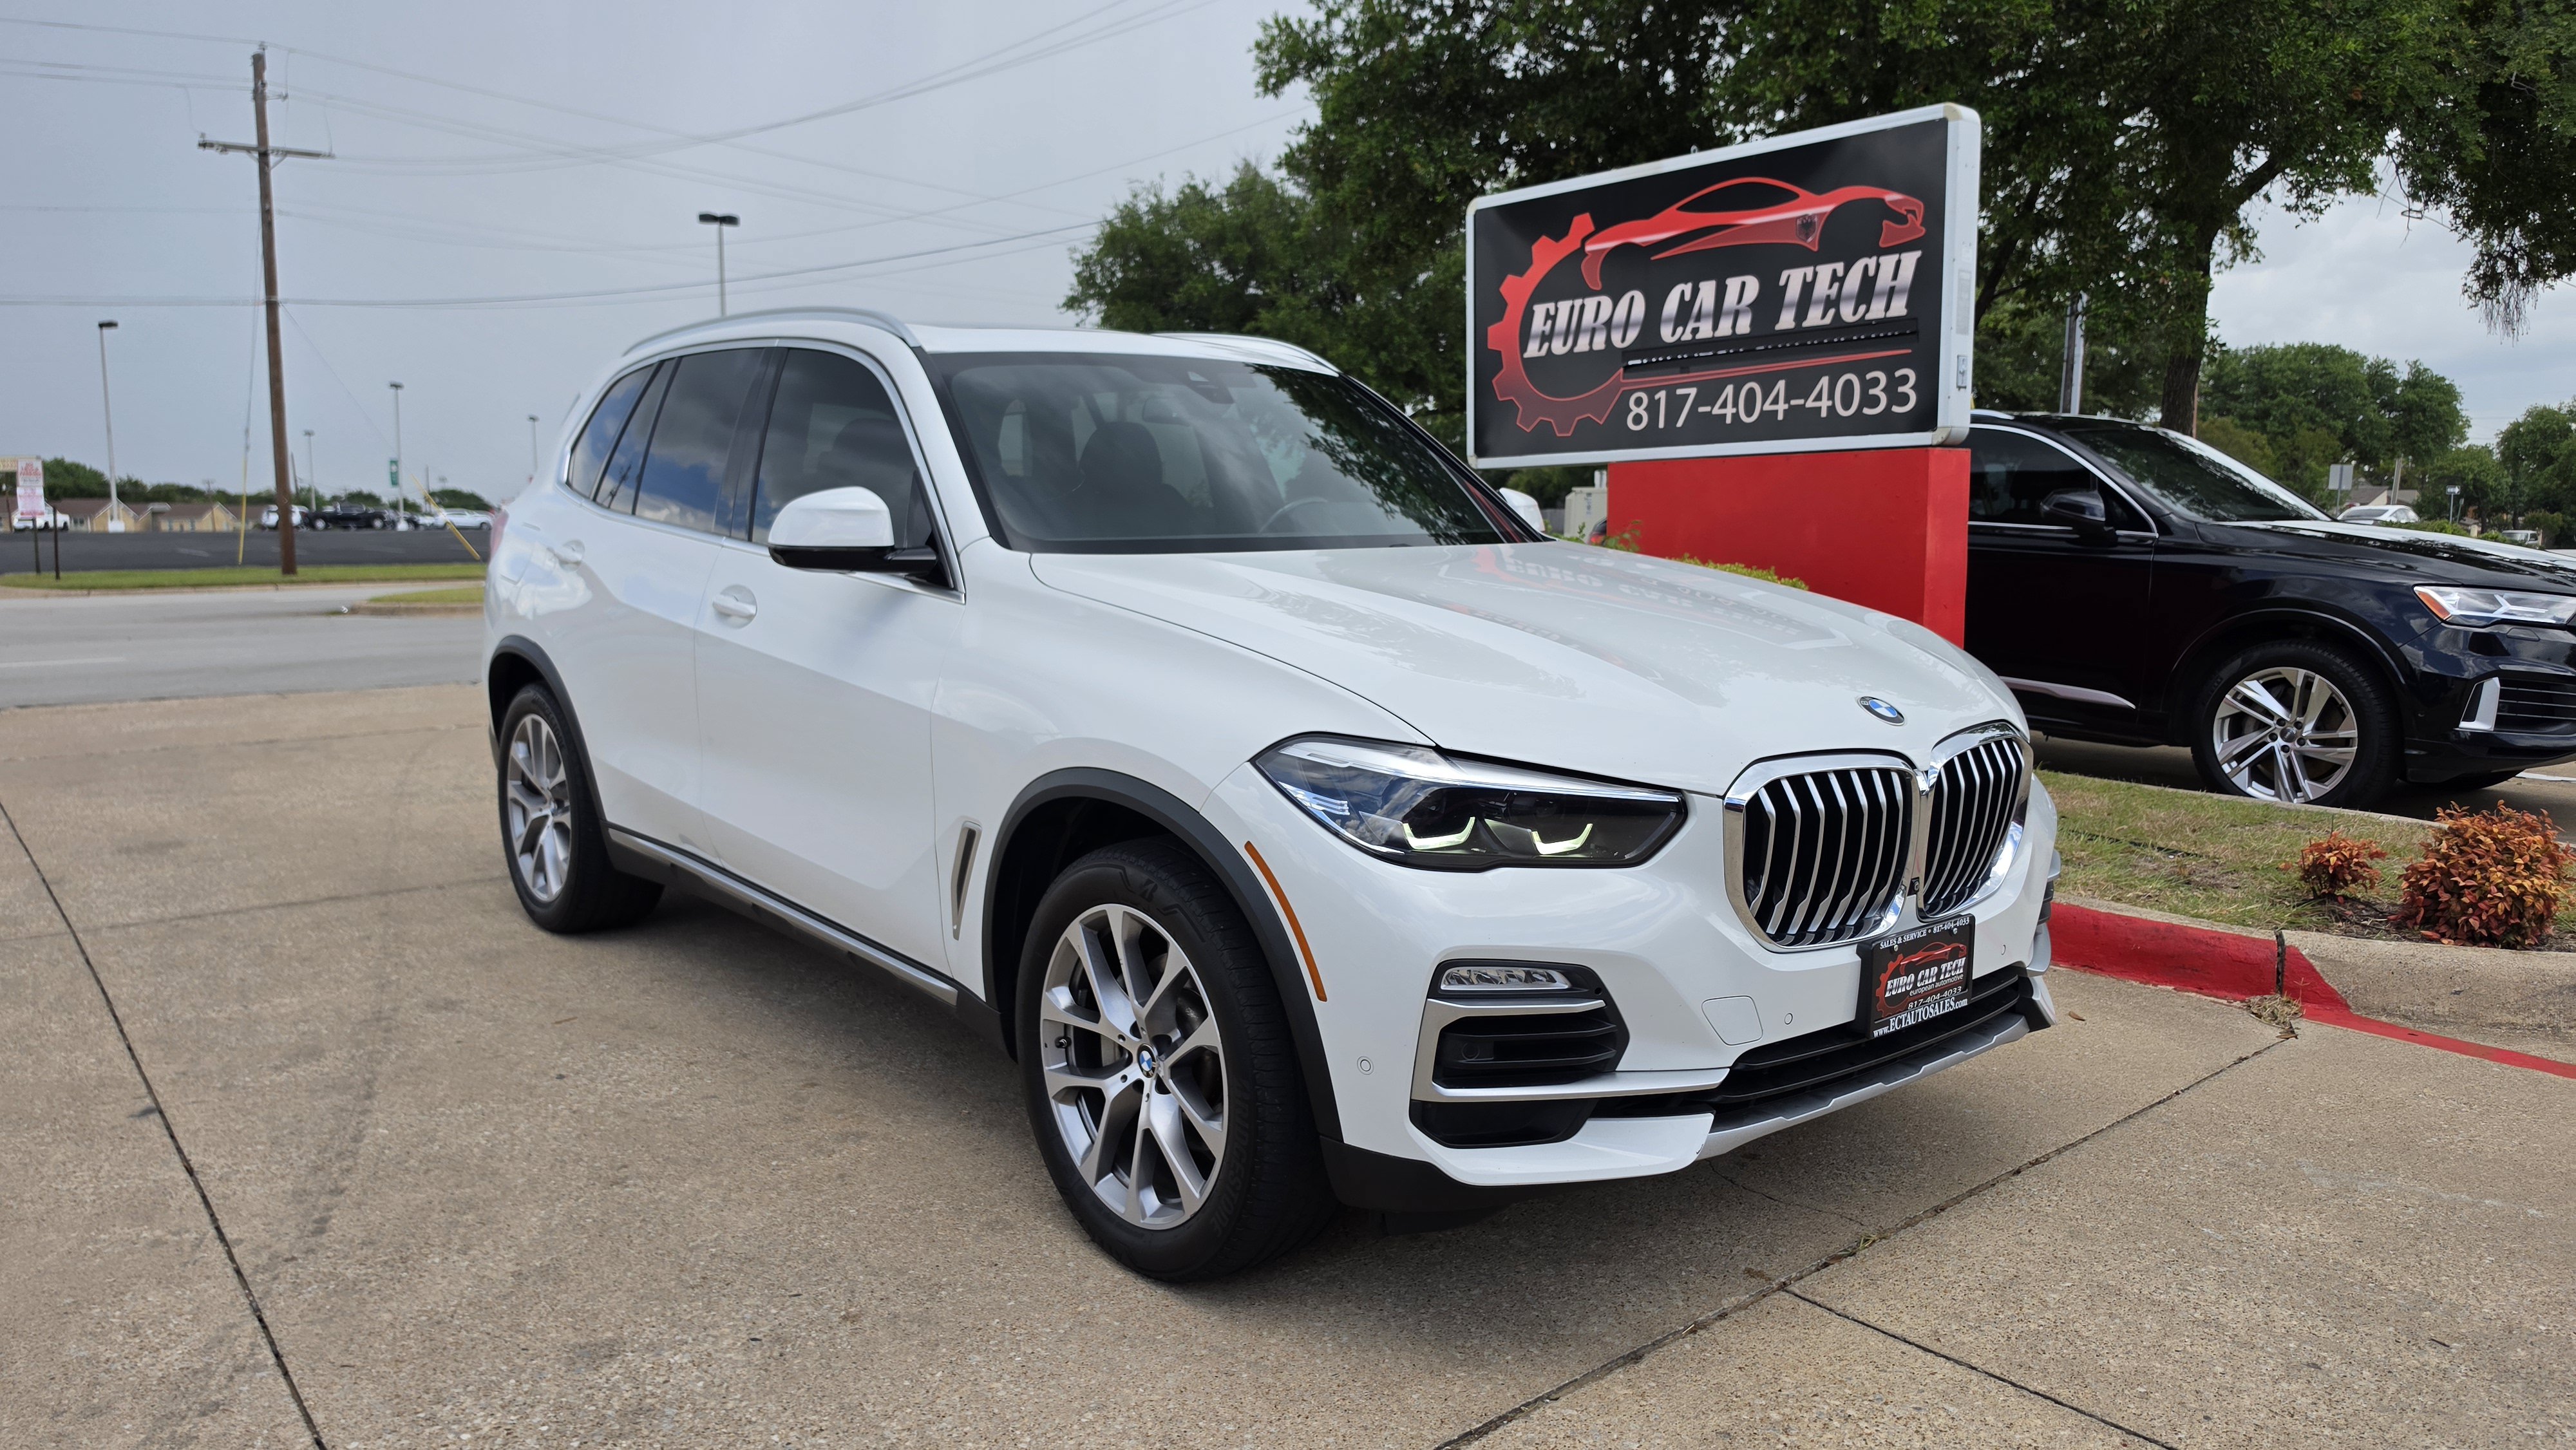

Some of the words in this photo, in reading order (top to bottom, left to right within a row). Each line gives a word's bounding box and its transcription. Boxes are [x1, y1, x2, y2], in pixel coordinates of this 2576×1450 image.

[1524, 289, 1645, 359] EURO
[1659, 275, 1761, 344] CAR
[1774, 250, 1922, 332] TECH
[1627, 368, 1918, 432] 817-404-4033
[1880, 938, 1897, 950] SALES
[1897, 936, 1902, 945] &
[1902, 929, 1927, 942] SERVICE
[1933, 917, 1970, 934] 817-404-4033
[1884, 974, 1915, 997] EURO
[1917, 966, 1938, 987] CAR
[1940, 957, 1966, 980] TECH
[1909, 984, 1935, 996] european
[1935, 974, 1964, 987] automotive
[1873, 997, 1968, 1039] www.ECTAUTOSALES.com
[1908, 986, 1962, 1010] 817-404-4033
